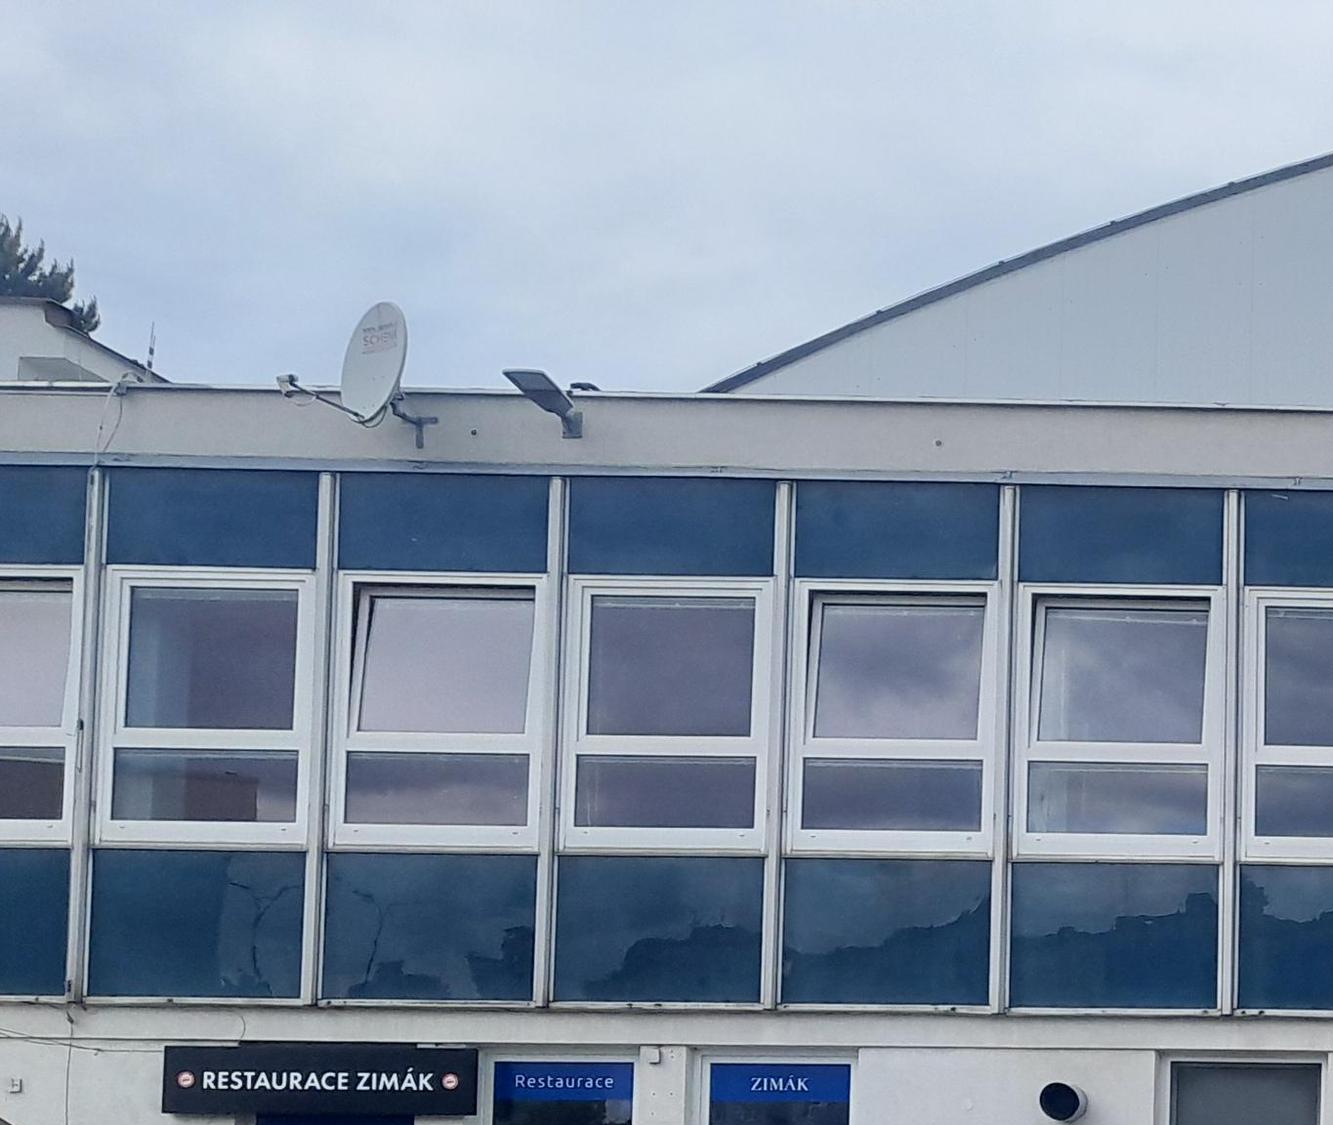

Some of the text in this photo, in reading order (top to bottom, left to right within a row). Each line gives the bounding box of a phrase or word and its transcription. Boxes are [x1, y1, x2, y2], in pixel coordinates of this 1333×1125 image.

[202, 1067, 434, 1092] RESTAURACE ZIMÁK
[515, 1073, 615, 1089] Restaurace
[751, 1075, 810, 1092] ZIMÁK
